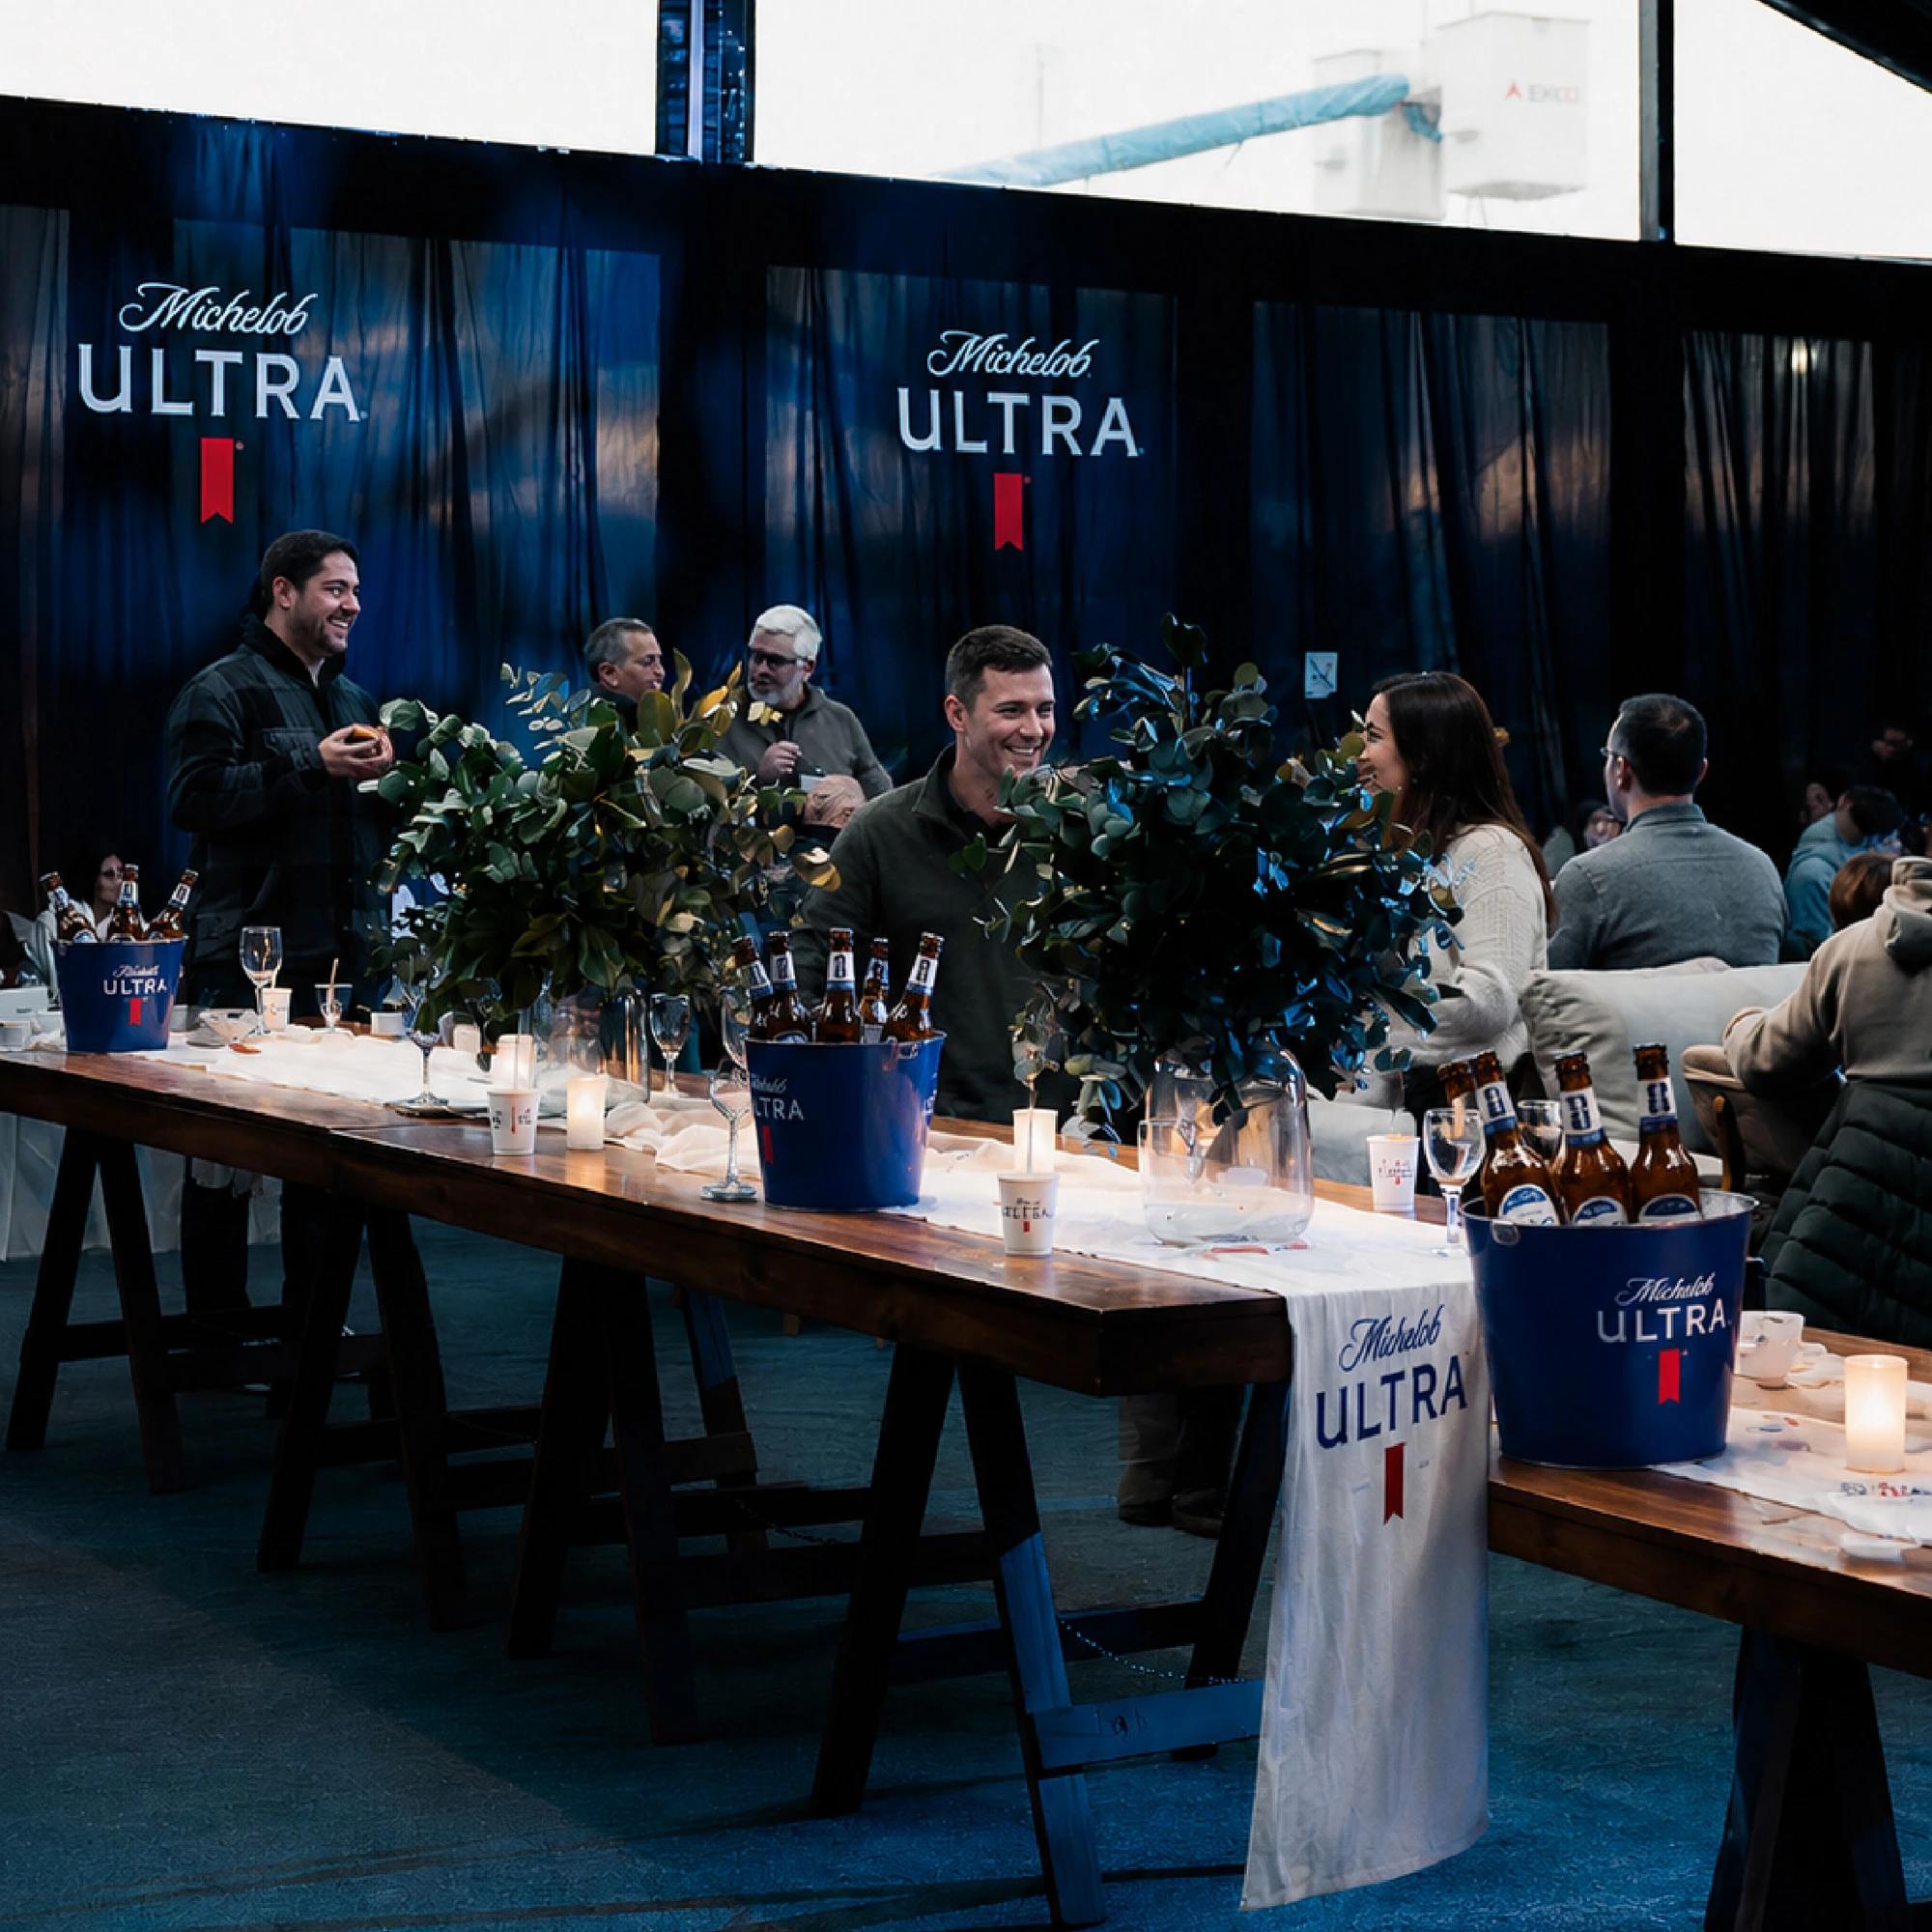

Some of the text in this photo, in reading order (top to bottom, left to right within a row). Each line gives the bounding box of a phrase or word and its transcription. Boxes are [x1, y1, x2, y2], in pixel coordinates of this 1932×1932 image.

[119, 282, 319, 334] Michelob
[927, 329, 1099, 378] Michelob
[77, 343, 362, 422] ULTRA
[897, 387, 1139, 457] ULTRA
[102, 978, 167, 995] ULTRA
[754, 1095, 805, 1121] LTRA
[1339, 1304, 1445, 1373] Michelob
[1597, 1298, 1727, 1343] ULTRA
[1316, 1354, 1467, 1449] ULTRA
